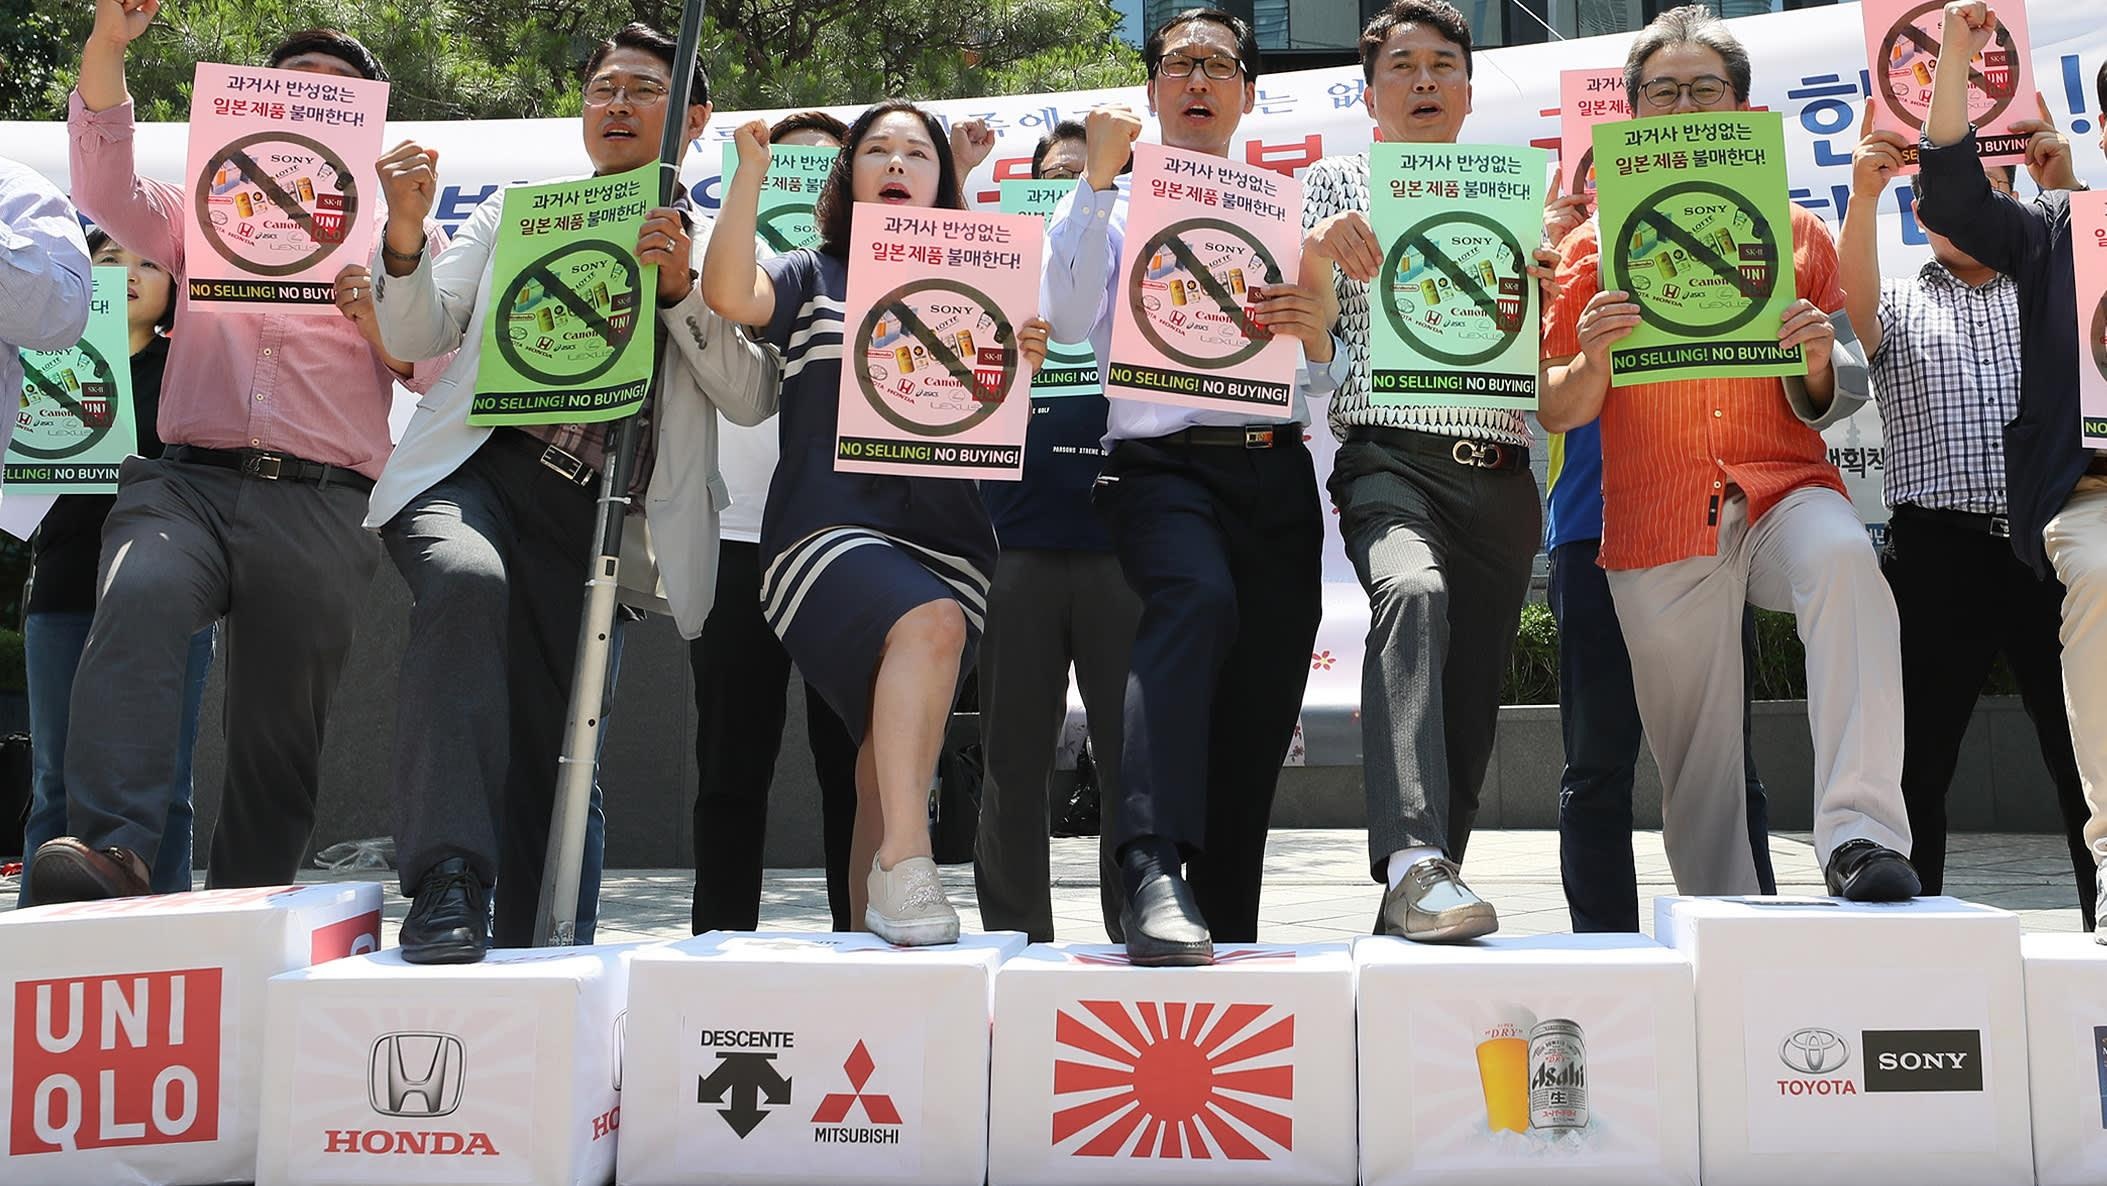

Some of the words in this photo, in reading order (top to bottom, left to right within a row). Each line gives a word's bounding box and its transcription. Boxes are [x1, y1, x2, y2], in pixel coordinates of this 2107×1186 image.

[227, 76, 280, 94] 과거사
[286, 80, 356, 103] 반성없는
[214, 98, 248, 116] 일본
[251, 102, 286, 120] 제품
[290, 105, 364, 128] 불매한다!
[1578, 100, 1606, 116] 일본
[1625, 126, 1678, 146] 과거사
[1683, 122, 1752, 142] 반성없는
[271, 154, 314, 164] SONY
[800, 156, 836, 172] 반성
[1400, 154, 1452, 170] 과거사
[1457, 154, 1522, 174] 반성없는
[1616, 156, 1650, 176] 일본
[1653, 150, 1688, 169] 제품
[1692, 148, 1766, 167] 불매한다!
[772, 176, 802, 192] 제품
[1164, 156, 1214, 180] 과거사
[1218, 166, 1278, 197] 반성없는
[532, 193, 580, 209] 과거사
[584, 180, 640, 206] 반성없는
[1390, 180, 1423, 198] 일본
[1426, 180, 1460, 198] 제품
[1464, 180, 1530, 200] 불매한다!
[1152, 180, 1183, 200] 일본
[1186, 184, 1218, 206] 제품
[1222, 192, 1286, 222] 불매한다!
[520, 218, 550, 236] 일본
[554, 213, 584, 231] 제품
[586, 200, 646, 228] 불매한다!
[1684, 206, 1728, 216] SONY
[264, 220, 301, 230] Canon
[884, 217, 938, 236] 과거사
[942, 221, 1012, 244] 반성없는
[228, 232, 255, 246] HONDA
[1452, 237, 1492, 246] SONY
[872, 242, 906, 262] 일본
[909, 245, 943, 265] 제품
[947, 248, 1020, 270] 불매한다!
[1205, 242, 1246, 255] SONY
[571, 260, 608, 274] SONY
[1689, 278, 1728, 287] Canon
[190, 284, 210, 296] NO
[214, 285, 276, 299] SELLING!
[280, 287, 299, 298] NO
[303, 288, 336, 300] BUYI
[930, 304, 973, 314] SONY
[1652, 296, 1682, 308] HONDA
[1196, 311, 1232, 323] Canon
[1450, 308, 1488, 318] Canon
[563, 330, 599, 340] Canon
[1160, 319, 1186, 336] HONDA
[1416, 320, 1444, 335] HONDA
[526, 345, 552, 358] HONDA
[1614, 354, 1636, 369] NO
[1641, 348, 1708, 366] SELLING!
[1713, 347, 1734, 360] NO
[1738, 346, 1799, 360] BUYING!
[924, 377, 962, 388] Canon
[1080, 371, 1098, 382] NO
[1110, 368, 1132, 382] NO
[1135, 371, 1199, 392] SELLING!
[1202, 380, 1224, 394] NO
[1228, 383, 1288, 402] BUYING!
[1374, 376, 1395, 388] NO
[1400, 376, 1462, 390] SELLING!
[1466, 378, 1486, 390] NO
[1489, 379, 1534, 394] BUYING!
[474, 398, 496, 410] NO
[500, 396, 564, 410] SELLING!
[568, 394, 590, 406] NO
[594, 384, 645, 406] BUYING!
[887, 388, 915, 404] HONDA
[840, 442, 862, 456] NO
[865, 444, 930, 460] SELLING!
[935, 448, 954, 462] NO
[960, 449, 1018, 464] BUYING!
[3, 468, 50, 480] ELLING!
[54, 468, 74, 479] NO
[78, 468, 119, 479] BUYIN
[36, 975, 185, 1053] UNI
[701, 1030, 794, 1048] DESCENTE
[1878, 1052, 1968, 1071] SONY
[1532, 1061, 1584, 1090] Asahi
[1777, 1080, 1857, 1096] TOYOTA
[1551, 1091, 1567, 1105] 生
[33, 1065, 198, 1150] QLO
[323, 1130, 500, 1155] HONDA
[814, 1127, 899, 1144] MITSUBISHI
